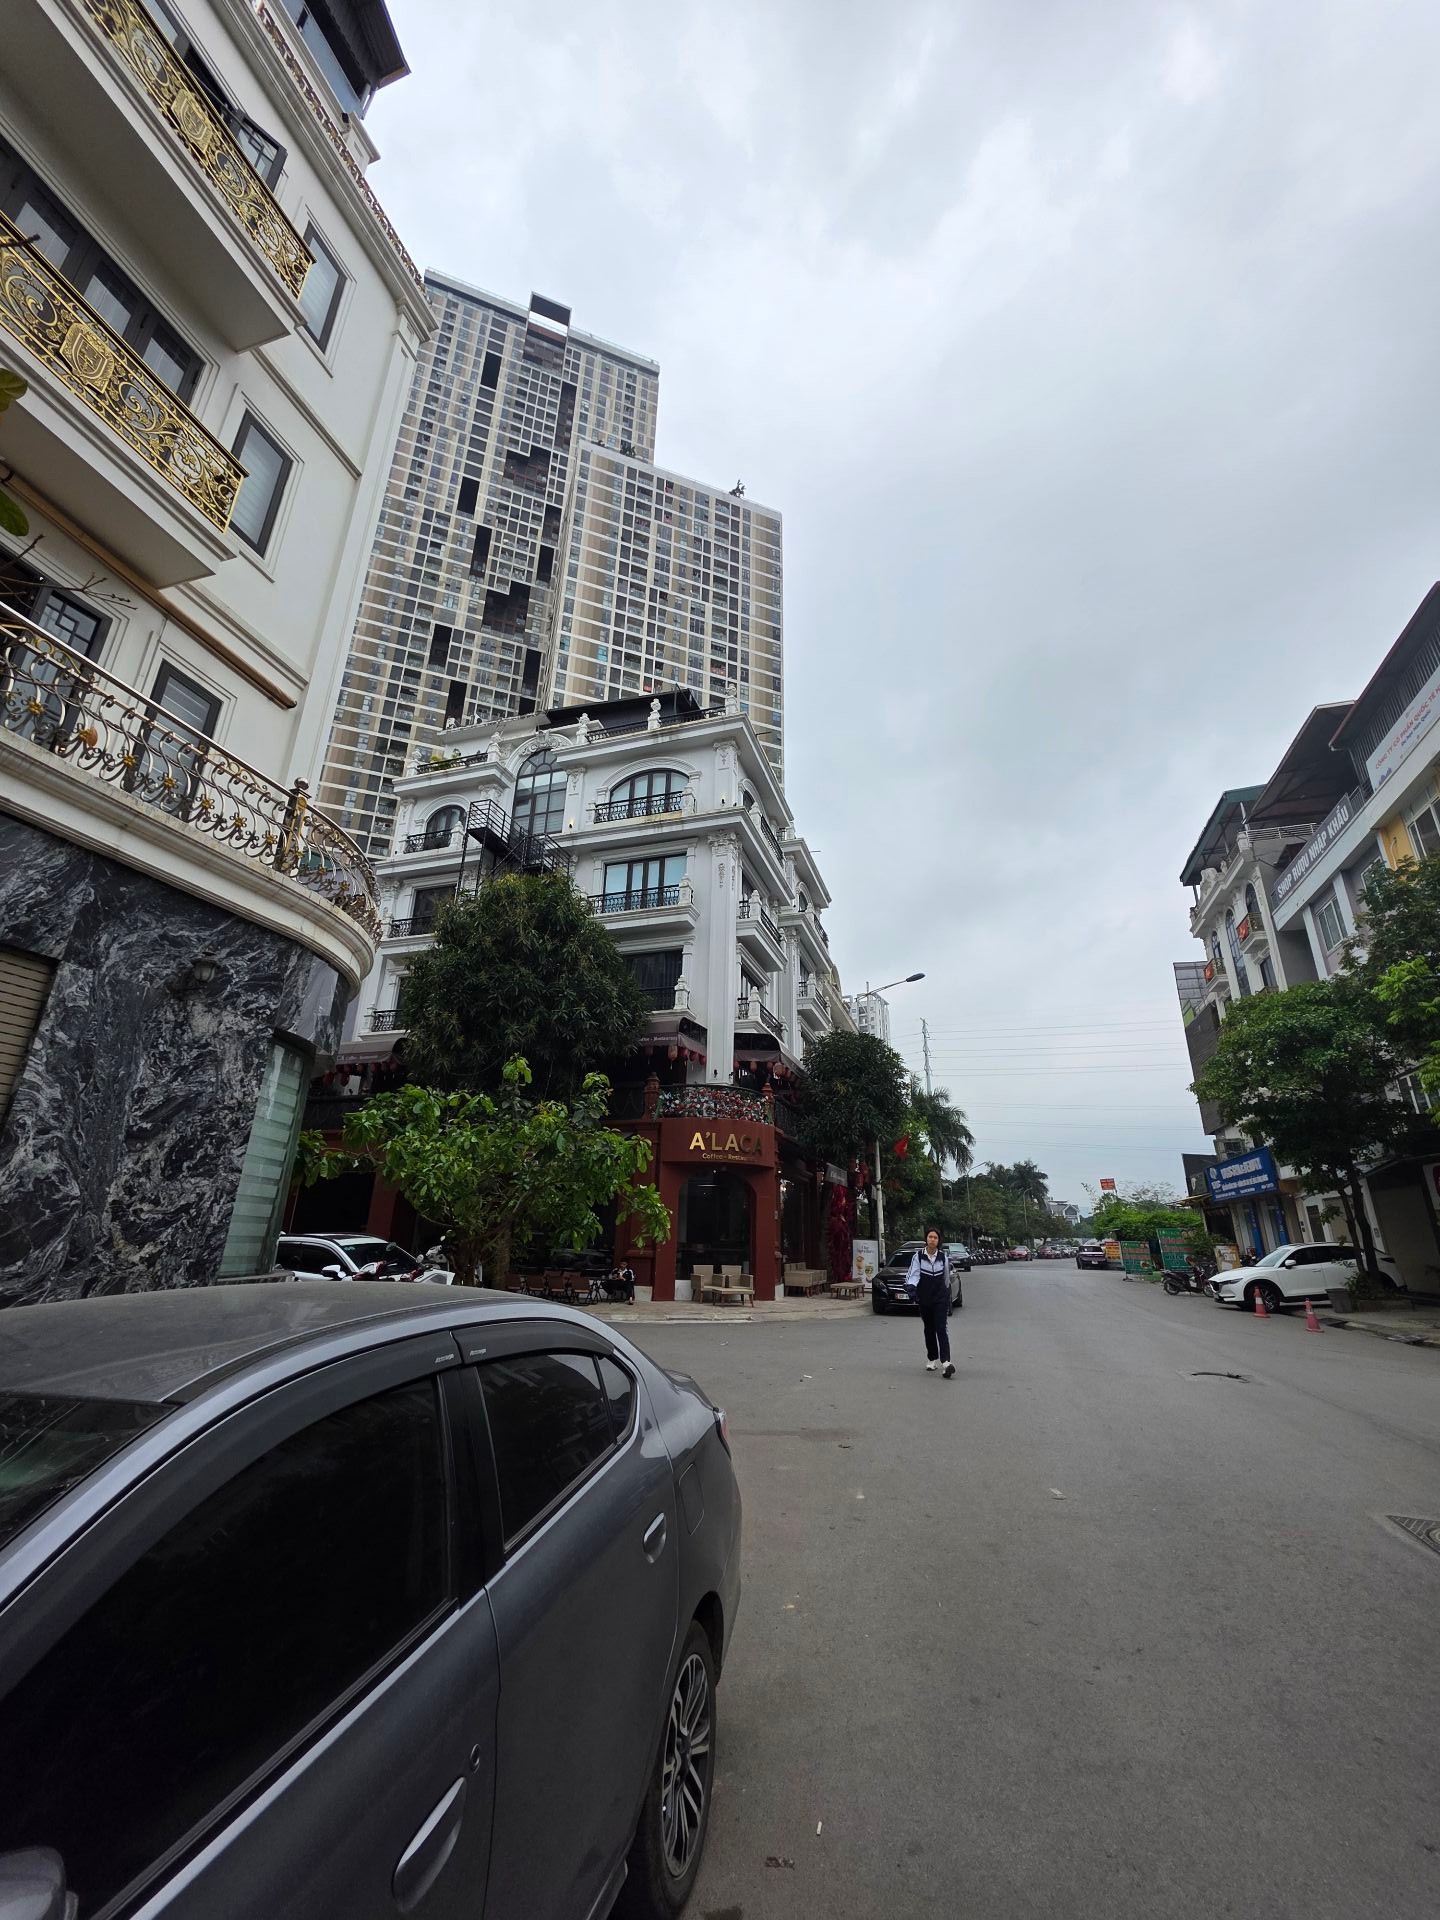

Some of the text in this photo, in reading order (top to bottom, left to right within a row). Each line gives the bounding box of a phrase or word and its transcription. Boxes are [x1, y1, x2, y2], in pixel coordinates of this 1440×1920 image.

[1277, 873, 1293, 898] SHOP
[1308, 831, 1327, 861] NHẬP
[1327, 805, 1349, 839] KHẨU
[702, 1152, 723, 1160] Coffee
